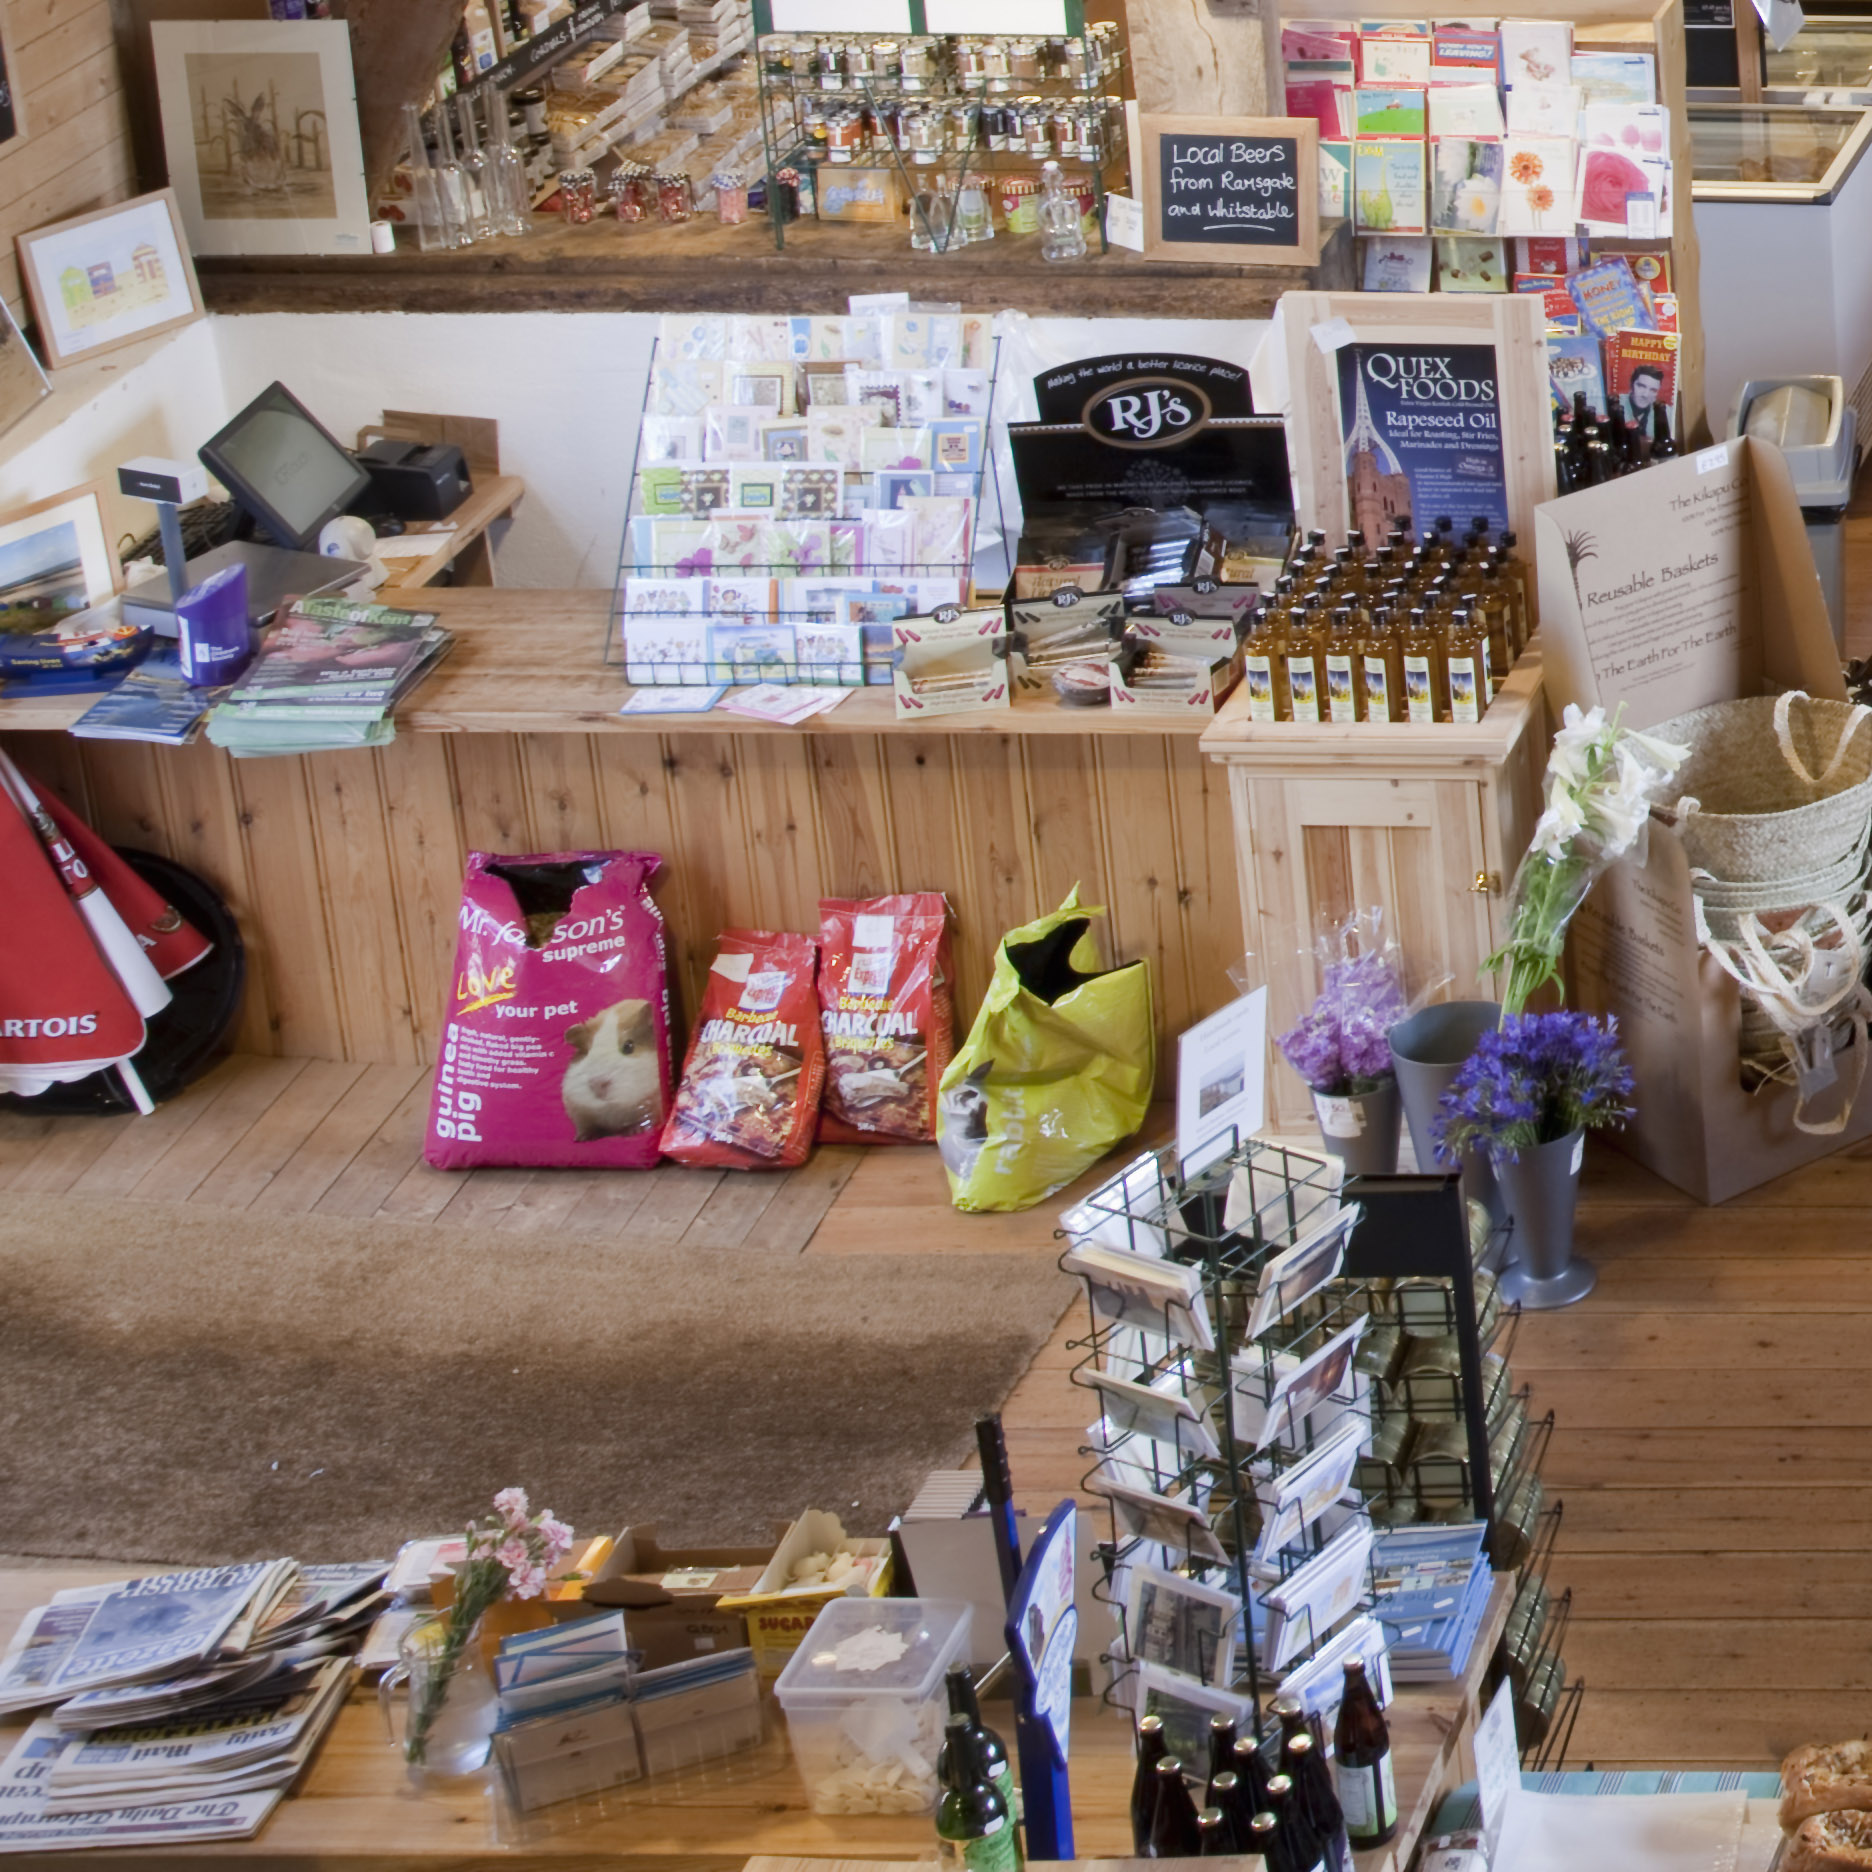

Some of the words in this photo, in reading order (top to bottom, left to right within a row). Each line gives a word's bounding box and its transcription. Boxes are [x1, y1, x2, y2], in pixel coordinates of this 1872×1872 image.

[1173, 143, 1223, 165] Local
[1230, 142, 1286, 164] Beers
[1170, 166, 1213, 193] from
[1221, 170, 1296, 196] Ramsgate
[1168, 203, 1201, 216] and
[1621, 349, 1671, 361] BIRTHDAY
[1631, 337, 1663, 348] HAPPY
[1367, 353, 1453, 389] QUEX
[1400, 378, 1494, 401] FOODS
[1107, 390, 1191, 438] RJ's
[1386, 411, 1464, 429] Rapeseed
[1470, 413, 1496, 428] Oil
[1669, 498, 1691, 512] The
[1693, 485, 1729, 506] Kikapu
[1587, 571, 1655, 608] Reusable
[1661, 552, 1719, 583] Baskets
[937, 608, 960, 623] RJ's
[1601, 662, 1625, 680] The
[1627, 652, 1661, 672] Earth
[1662, 646, 1681, 659] For
[1683, 637, 1704, 655] The
[1705, 621, 1737, 643] Earth
[459, 906, 488, 936] Mr.
[542, 935, 625, 963] supreme
[496, 1003, 537, 1019] your
[545, 1000, 578, 1019] pet
[0, 1013, 97, 1038] RTOIS
[700, 1019, 799, 1047] CHARCOAL
[821, 1009, 918, 1037] CHARCOAL
[436, 1023, 459, 1139] guinea
[453, 1090, 482, 1142] pig
[227, 1722, 291, 1747] Daily
[131, 1743, 192, 1761] Mail
[121, 1807, 184, 1824] Daily
[186, 1801, 239, 1817] The
